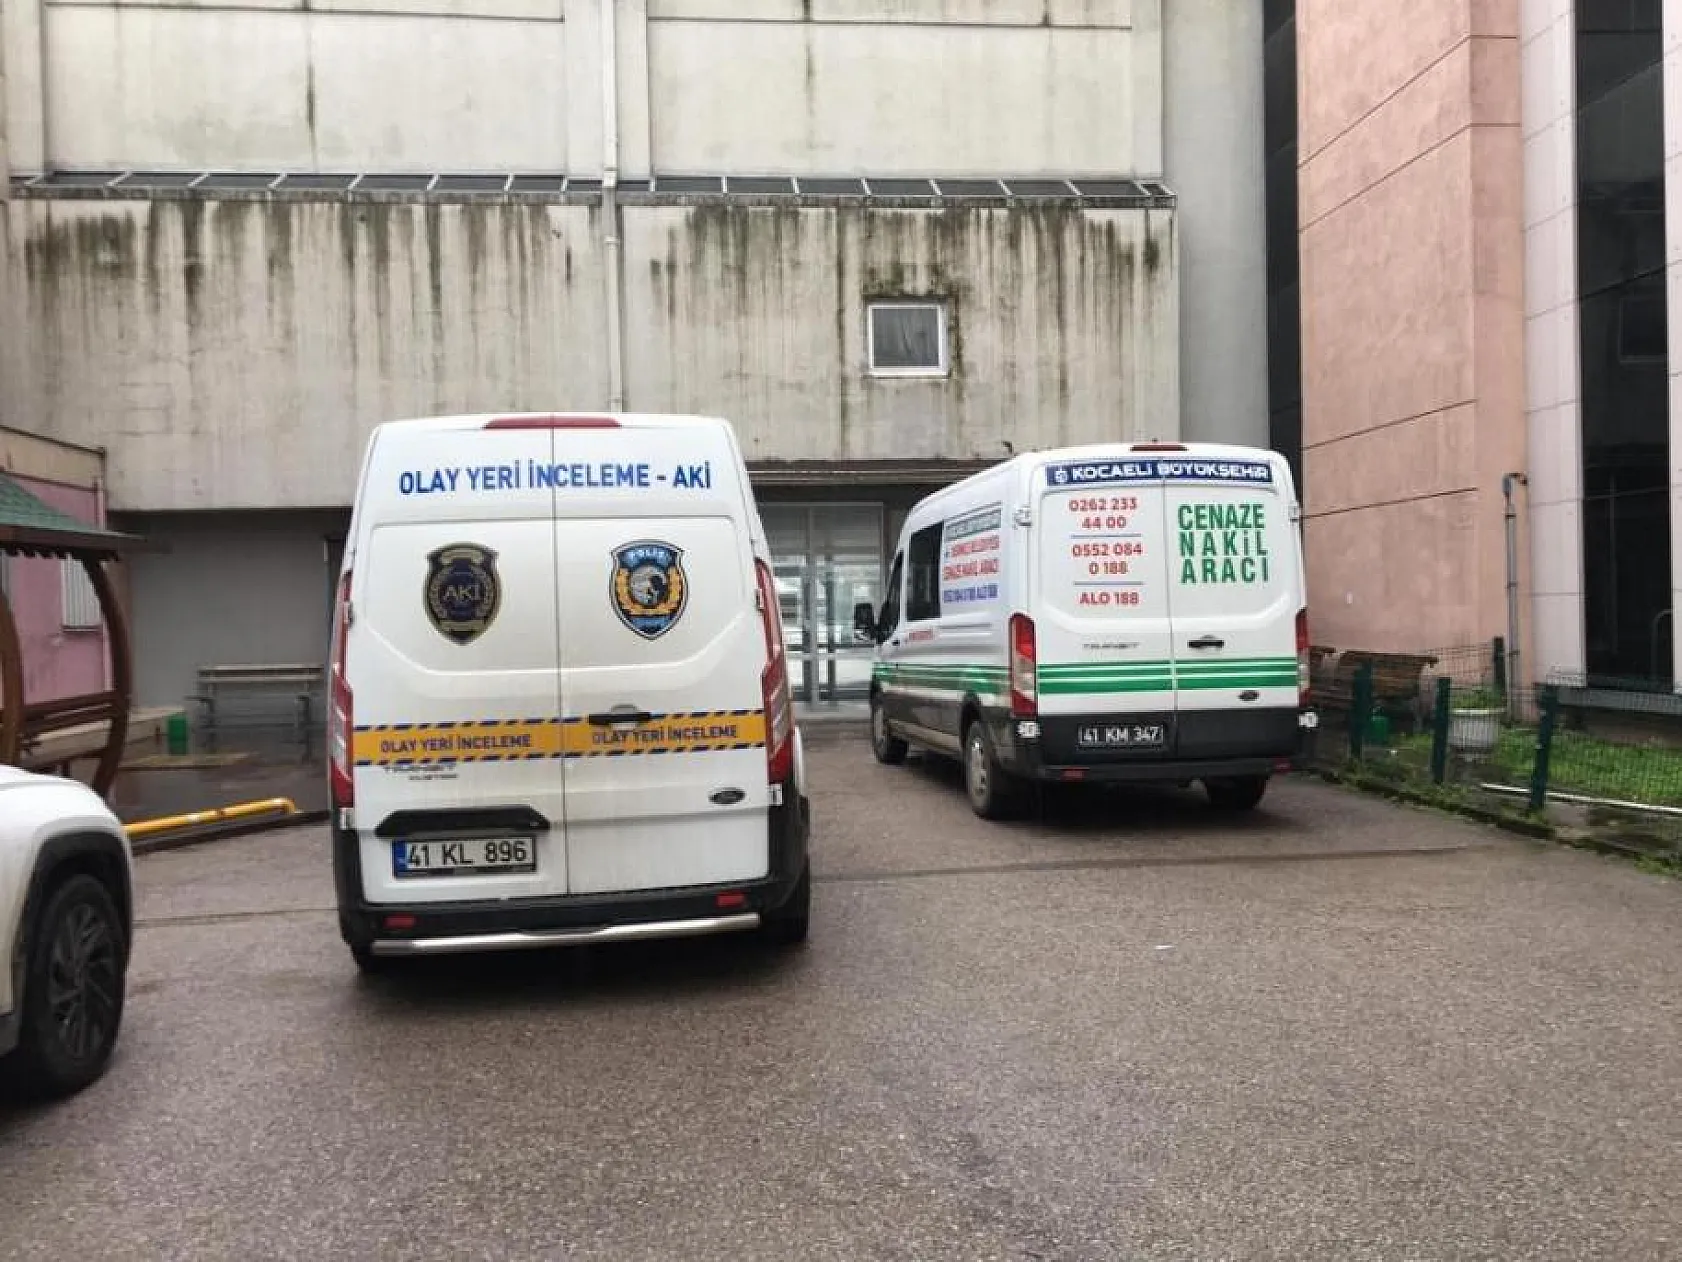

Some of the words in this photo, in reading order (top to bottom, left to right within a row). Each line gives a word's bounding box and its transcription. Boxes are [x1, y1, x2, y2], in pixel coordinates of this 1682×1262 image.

[400, 467, 460, 494] OLAY
[466, 459, 520, 490] YERİ
[529, 458, 651, 488] İNCELEME
[673, 460, 711, 488] AKİ
[1082, 516, 1101, 529] 44
[1106, 515, 1126, 528] 00
[1178, 504, 1265, 530] CENAZE
[1072, 544, 1109, 557] 0552
[1181, 557, 1268, 583] ARACI
[1080, 591, 1110, 605] ALO
[593, 730, 627, 743] OLAY
[381, 739, 416, 752] OLAY
[408, 844, 429, 866] 41
[443, 843, 475, 865] KL
[485, 840, 527, 863] 896
